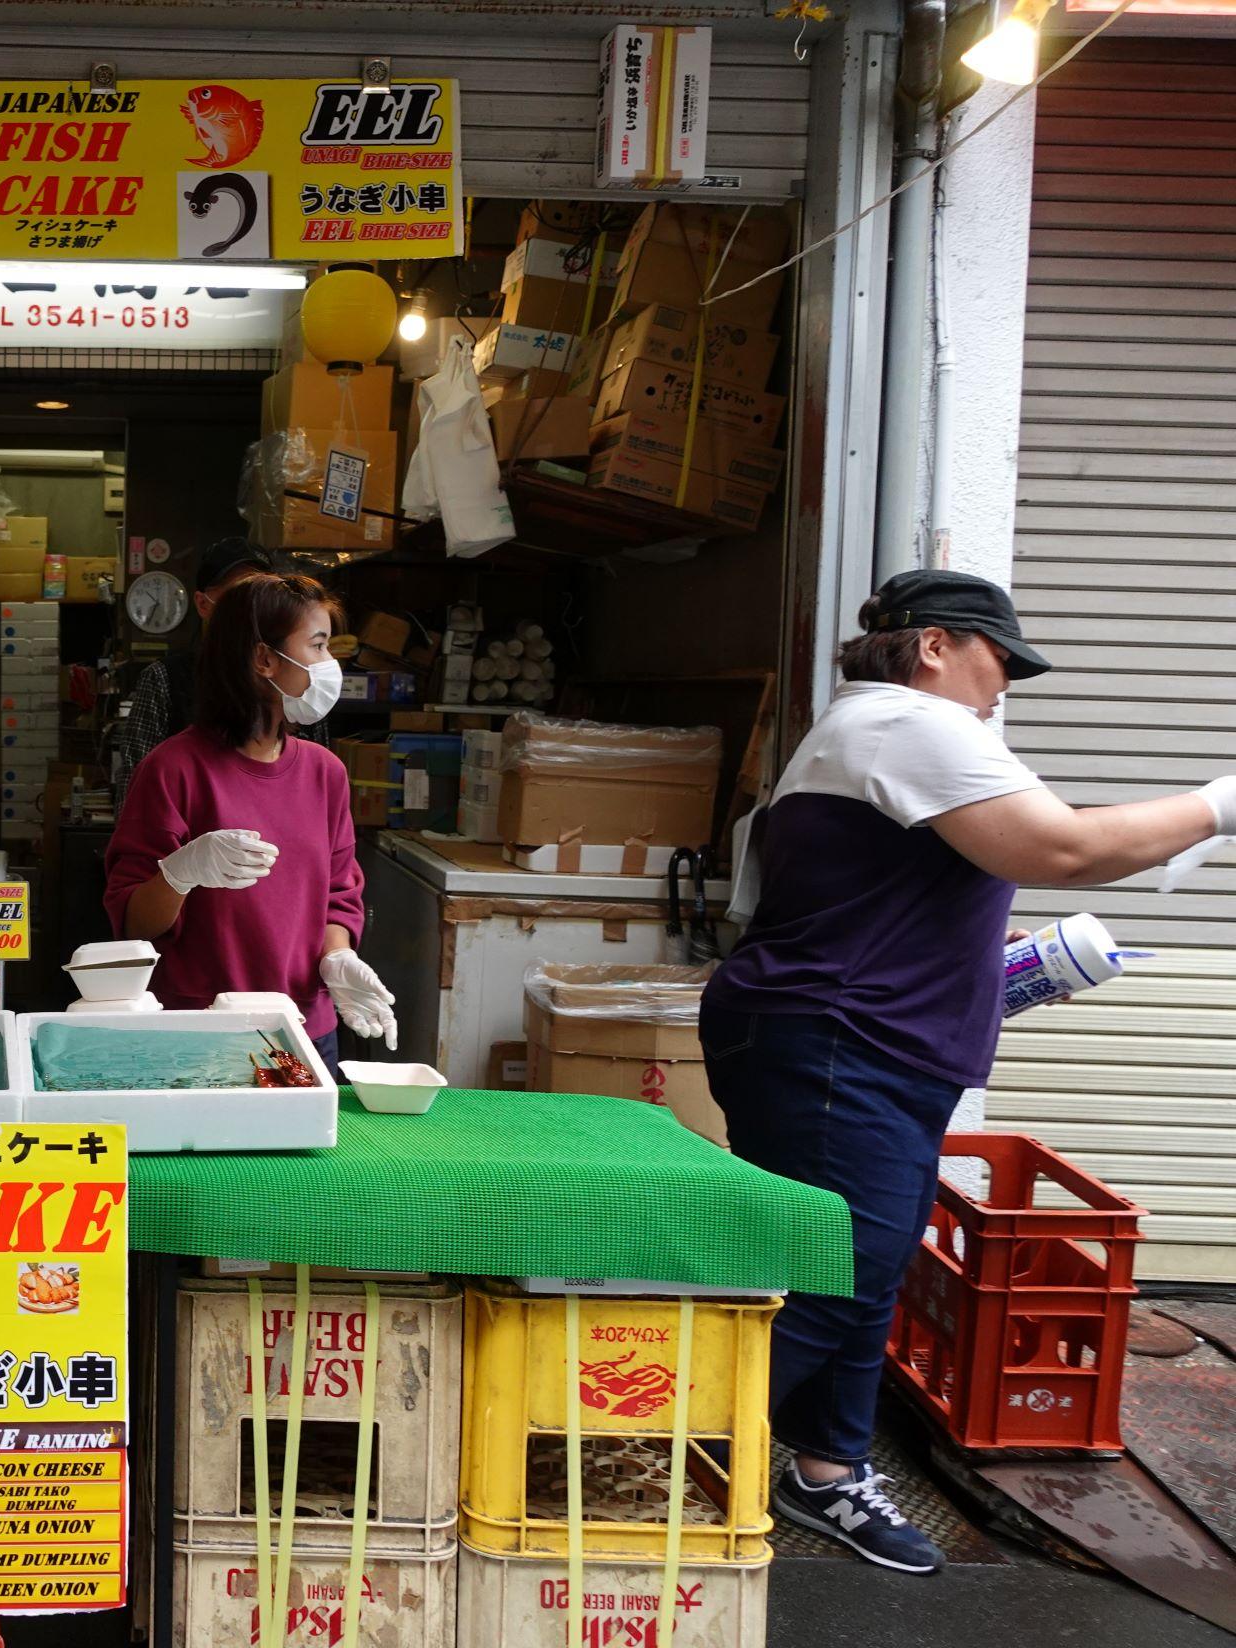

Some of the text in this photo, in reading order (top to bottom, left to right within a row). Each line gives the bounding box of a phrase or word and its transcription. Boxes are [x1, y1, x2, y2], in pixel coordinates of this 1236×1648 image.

[301, 83, 443, 145] EEL
[301, 147, 363, 163] UNAGI
[300, 182, 447, 215] うなぎ小串
[15, 219, 117, 232] フィシュケーキ
[301, 219, 452, 242] EEL BITE SIZE
[29, 235, 103, 248] さつま揚げ
[27, 305, 190, 329] 3541-0513
[24, 1433, 111, 1449] RANKING
[33, 1462, 105, 1477] CHEESE
[34, 1486, 71, 1496] TAKO
[5, 1500, 77, 1511] DUMPLING
[35, 1520, 95, 1534] ONION
[22, 1552, 110, 1567] DUMPLING
[40, 1582, 99, 1597] ONION
[305, 1584, 346, 1601] ASAHI
[539, 1580, 570, 1609] 20
[583, 1594, 615, 1610] BEER
[622, 1595, 661, 1611] ASAHI
